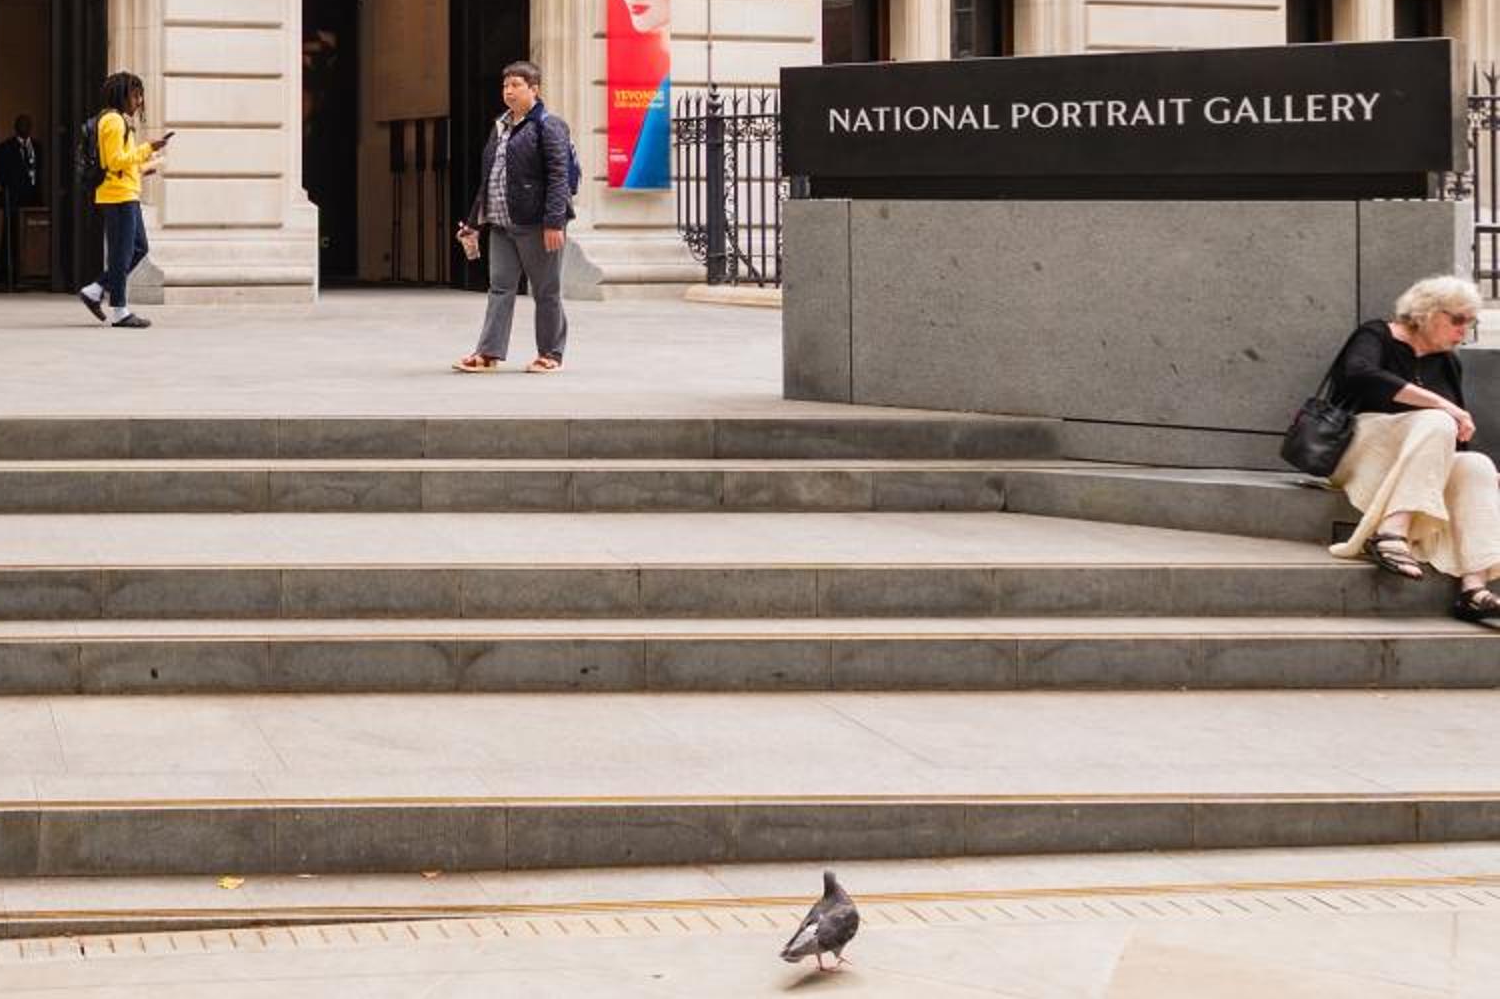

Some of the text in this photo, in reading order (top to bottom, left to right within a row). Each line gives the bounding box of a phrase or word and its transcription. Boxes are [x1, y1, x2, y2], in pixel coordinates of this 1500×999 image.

[829, 92, 1380, 132] NATIONAL PORTRAIT GALLERY
